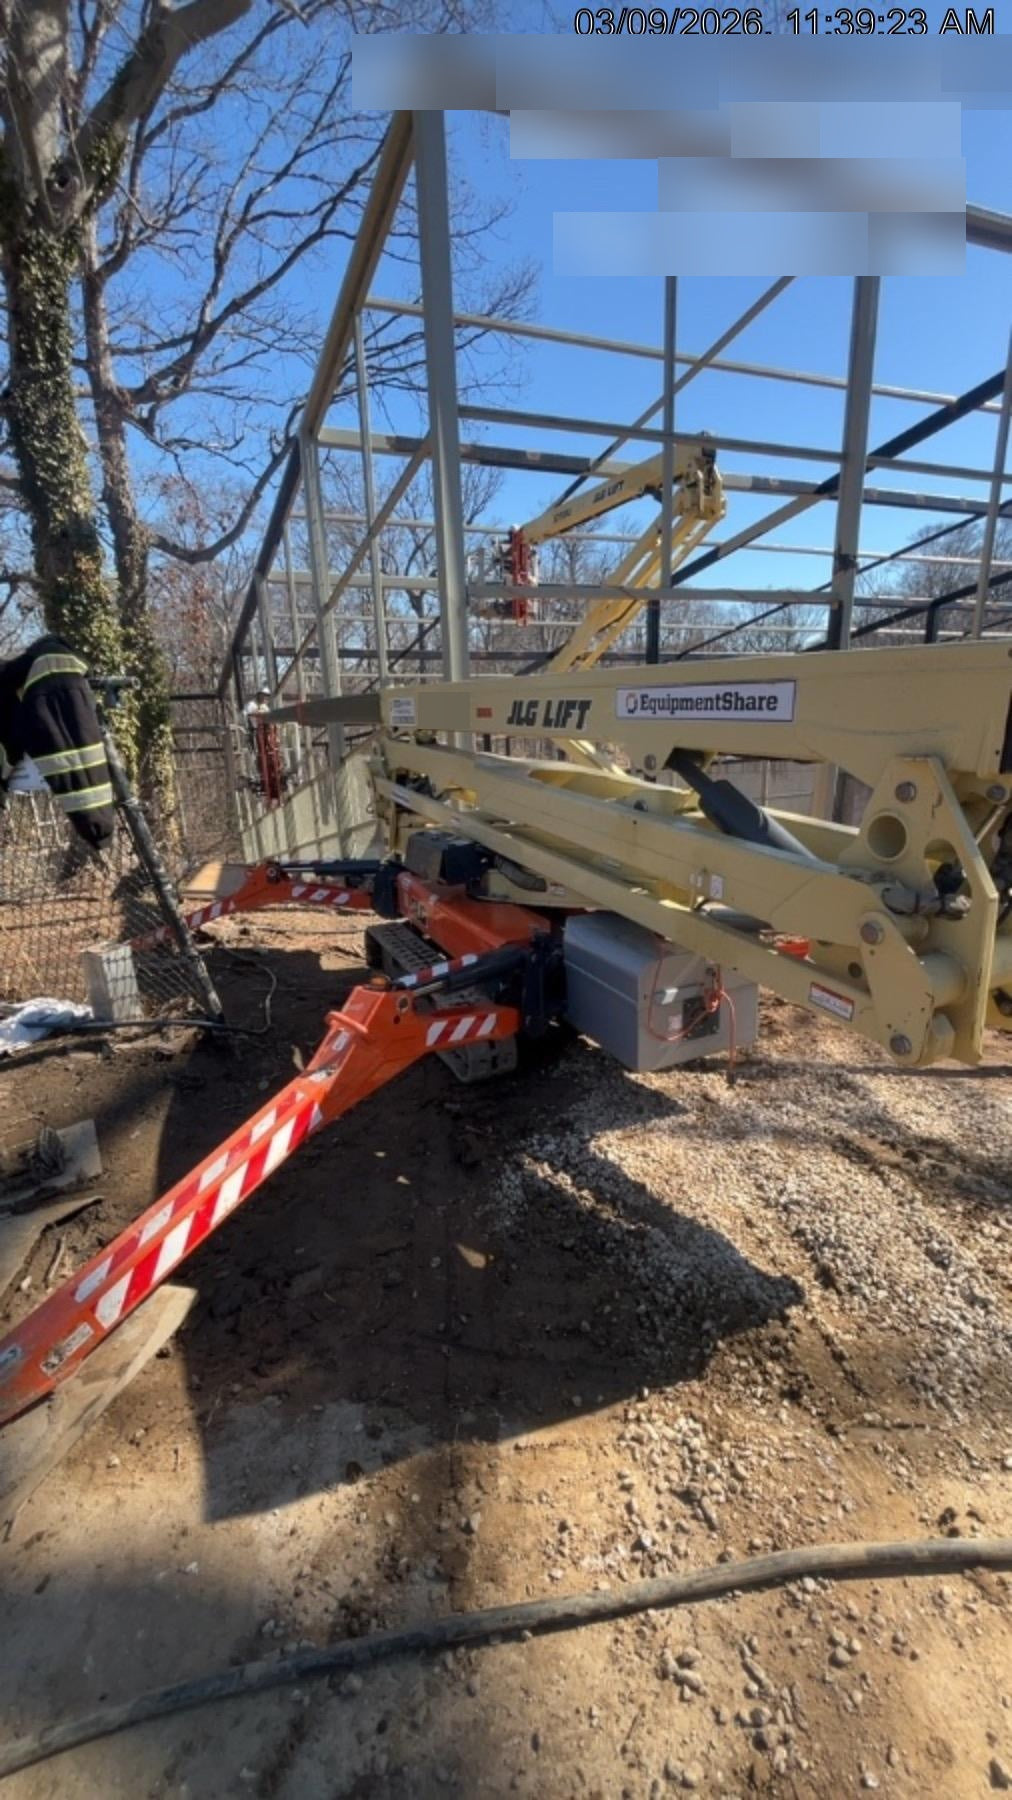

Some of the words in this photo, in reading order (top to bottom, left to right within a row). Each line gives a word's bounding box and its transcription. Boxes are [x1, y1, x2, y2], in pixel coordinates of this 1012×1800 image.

[507, 700, 538, 726] JLG
[542, 700, 592, 730] LIFT
[640, 691, 778, 715] EquipmentShare
